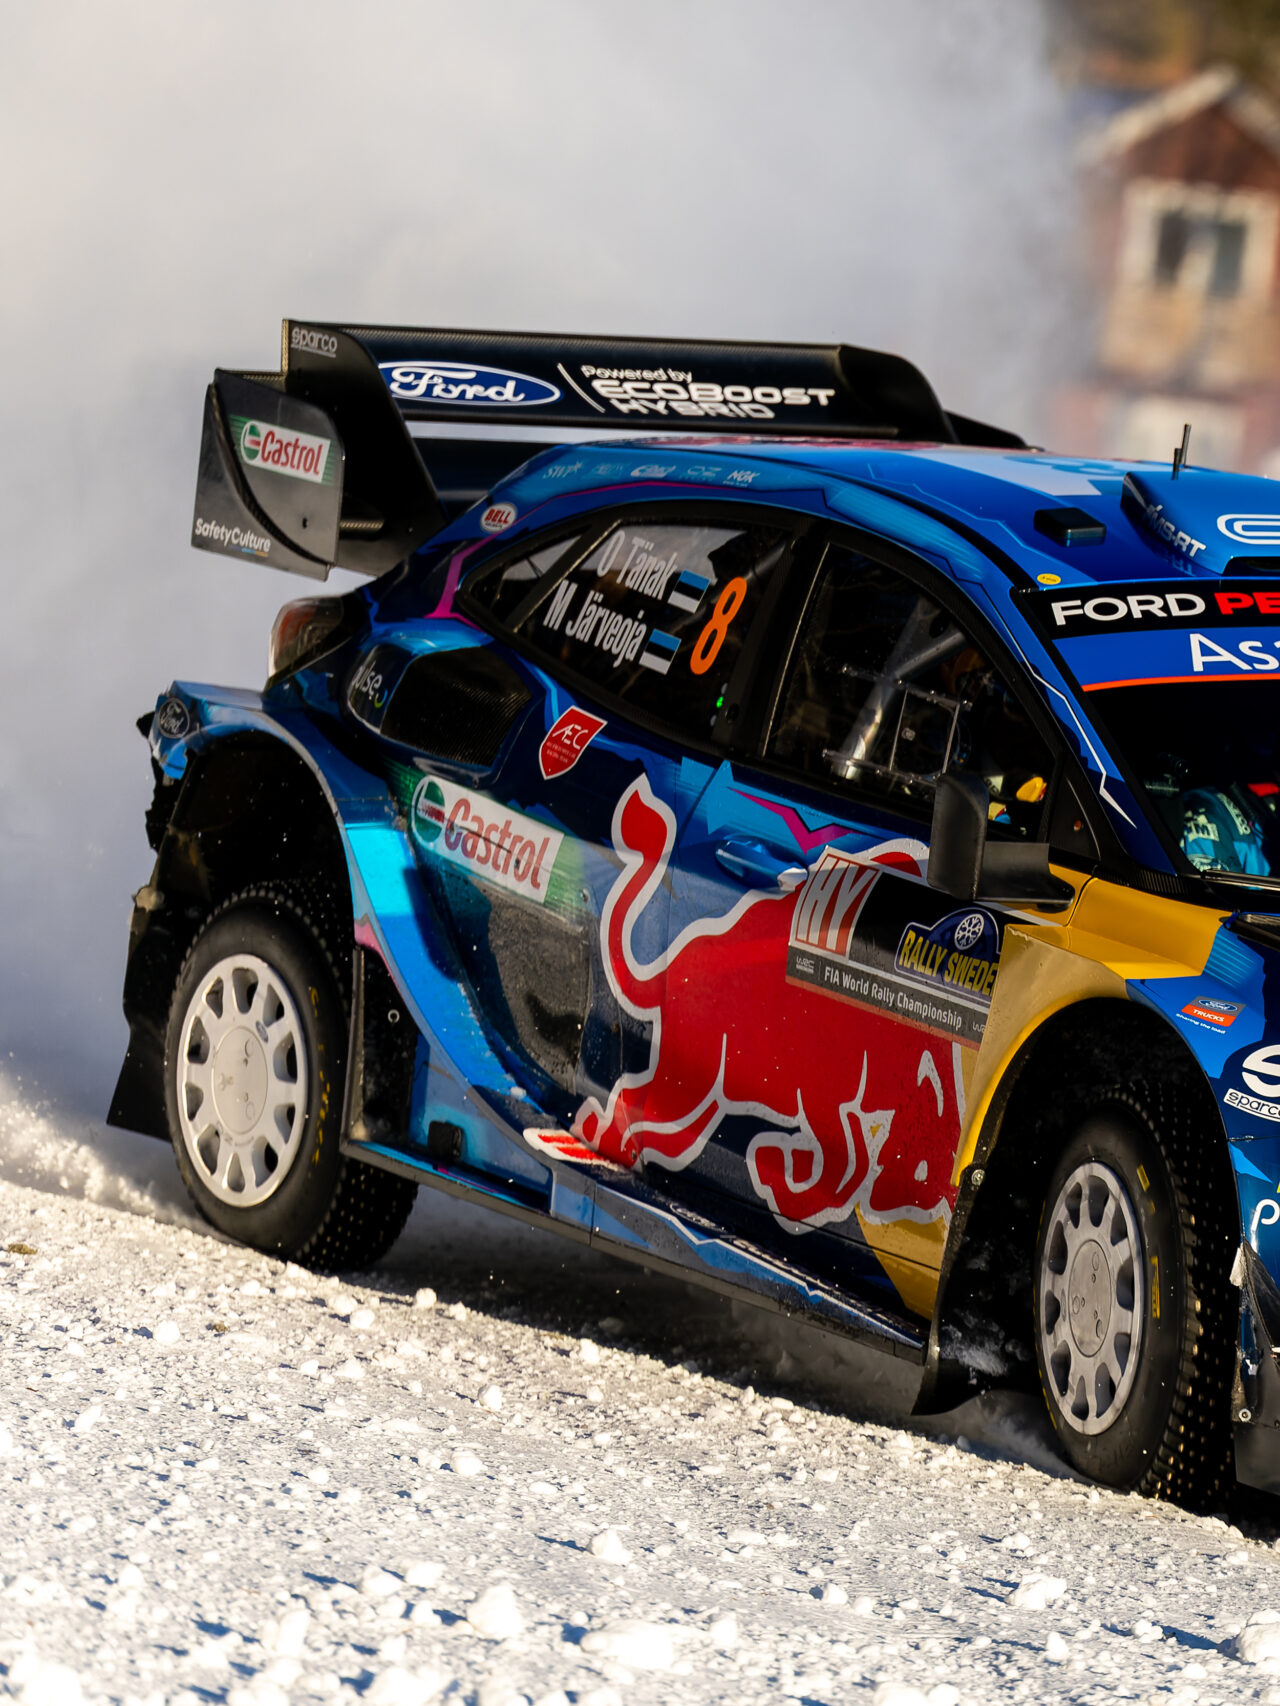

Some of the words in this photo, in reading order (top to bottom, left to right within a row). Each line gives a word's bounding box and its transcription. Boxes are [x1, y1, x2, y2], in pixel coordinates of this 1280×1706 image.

[291, 326, 338, 351] sparco
[389, 367, 525, 402] Ford
[580, 365, 667, 382] Powered
[668, 368, 693, 384] by
[591, 379, 835, 406] ECOBOOST
[610, 398, 775, 419] HYBRID
[260, 430, 323, 476] Castrol
[484, 508, 511, 524] BELL
[195, 518, 271, 552] SafetyCulture
[596, 530, 625, 578] O
[616, 536, 678, 600] Tänak
[543, 579, 578, 631] M
[565, 590, 647, 668] Järveoja
[690, 576, 748, 675] 8
[1051, 593, 1206, 626] FORD
[444, 797, 550, 890] Castrol
[798, 857, 877, 951] HY
[898, 929, 949, 979] RALLY
[944, 951, 999, 997] SWEDE
[824, 966, 840, 986] FIA
[842, 972, 870, 995] World
[871, 984, 895, 1008] Rally
[896, 992, 963, 1031] Championship
[1193, 1009, 1225, 1022] TRUCKS
[1200, 1021, 1211, 1029] the
